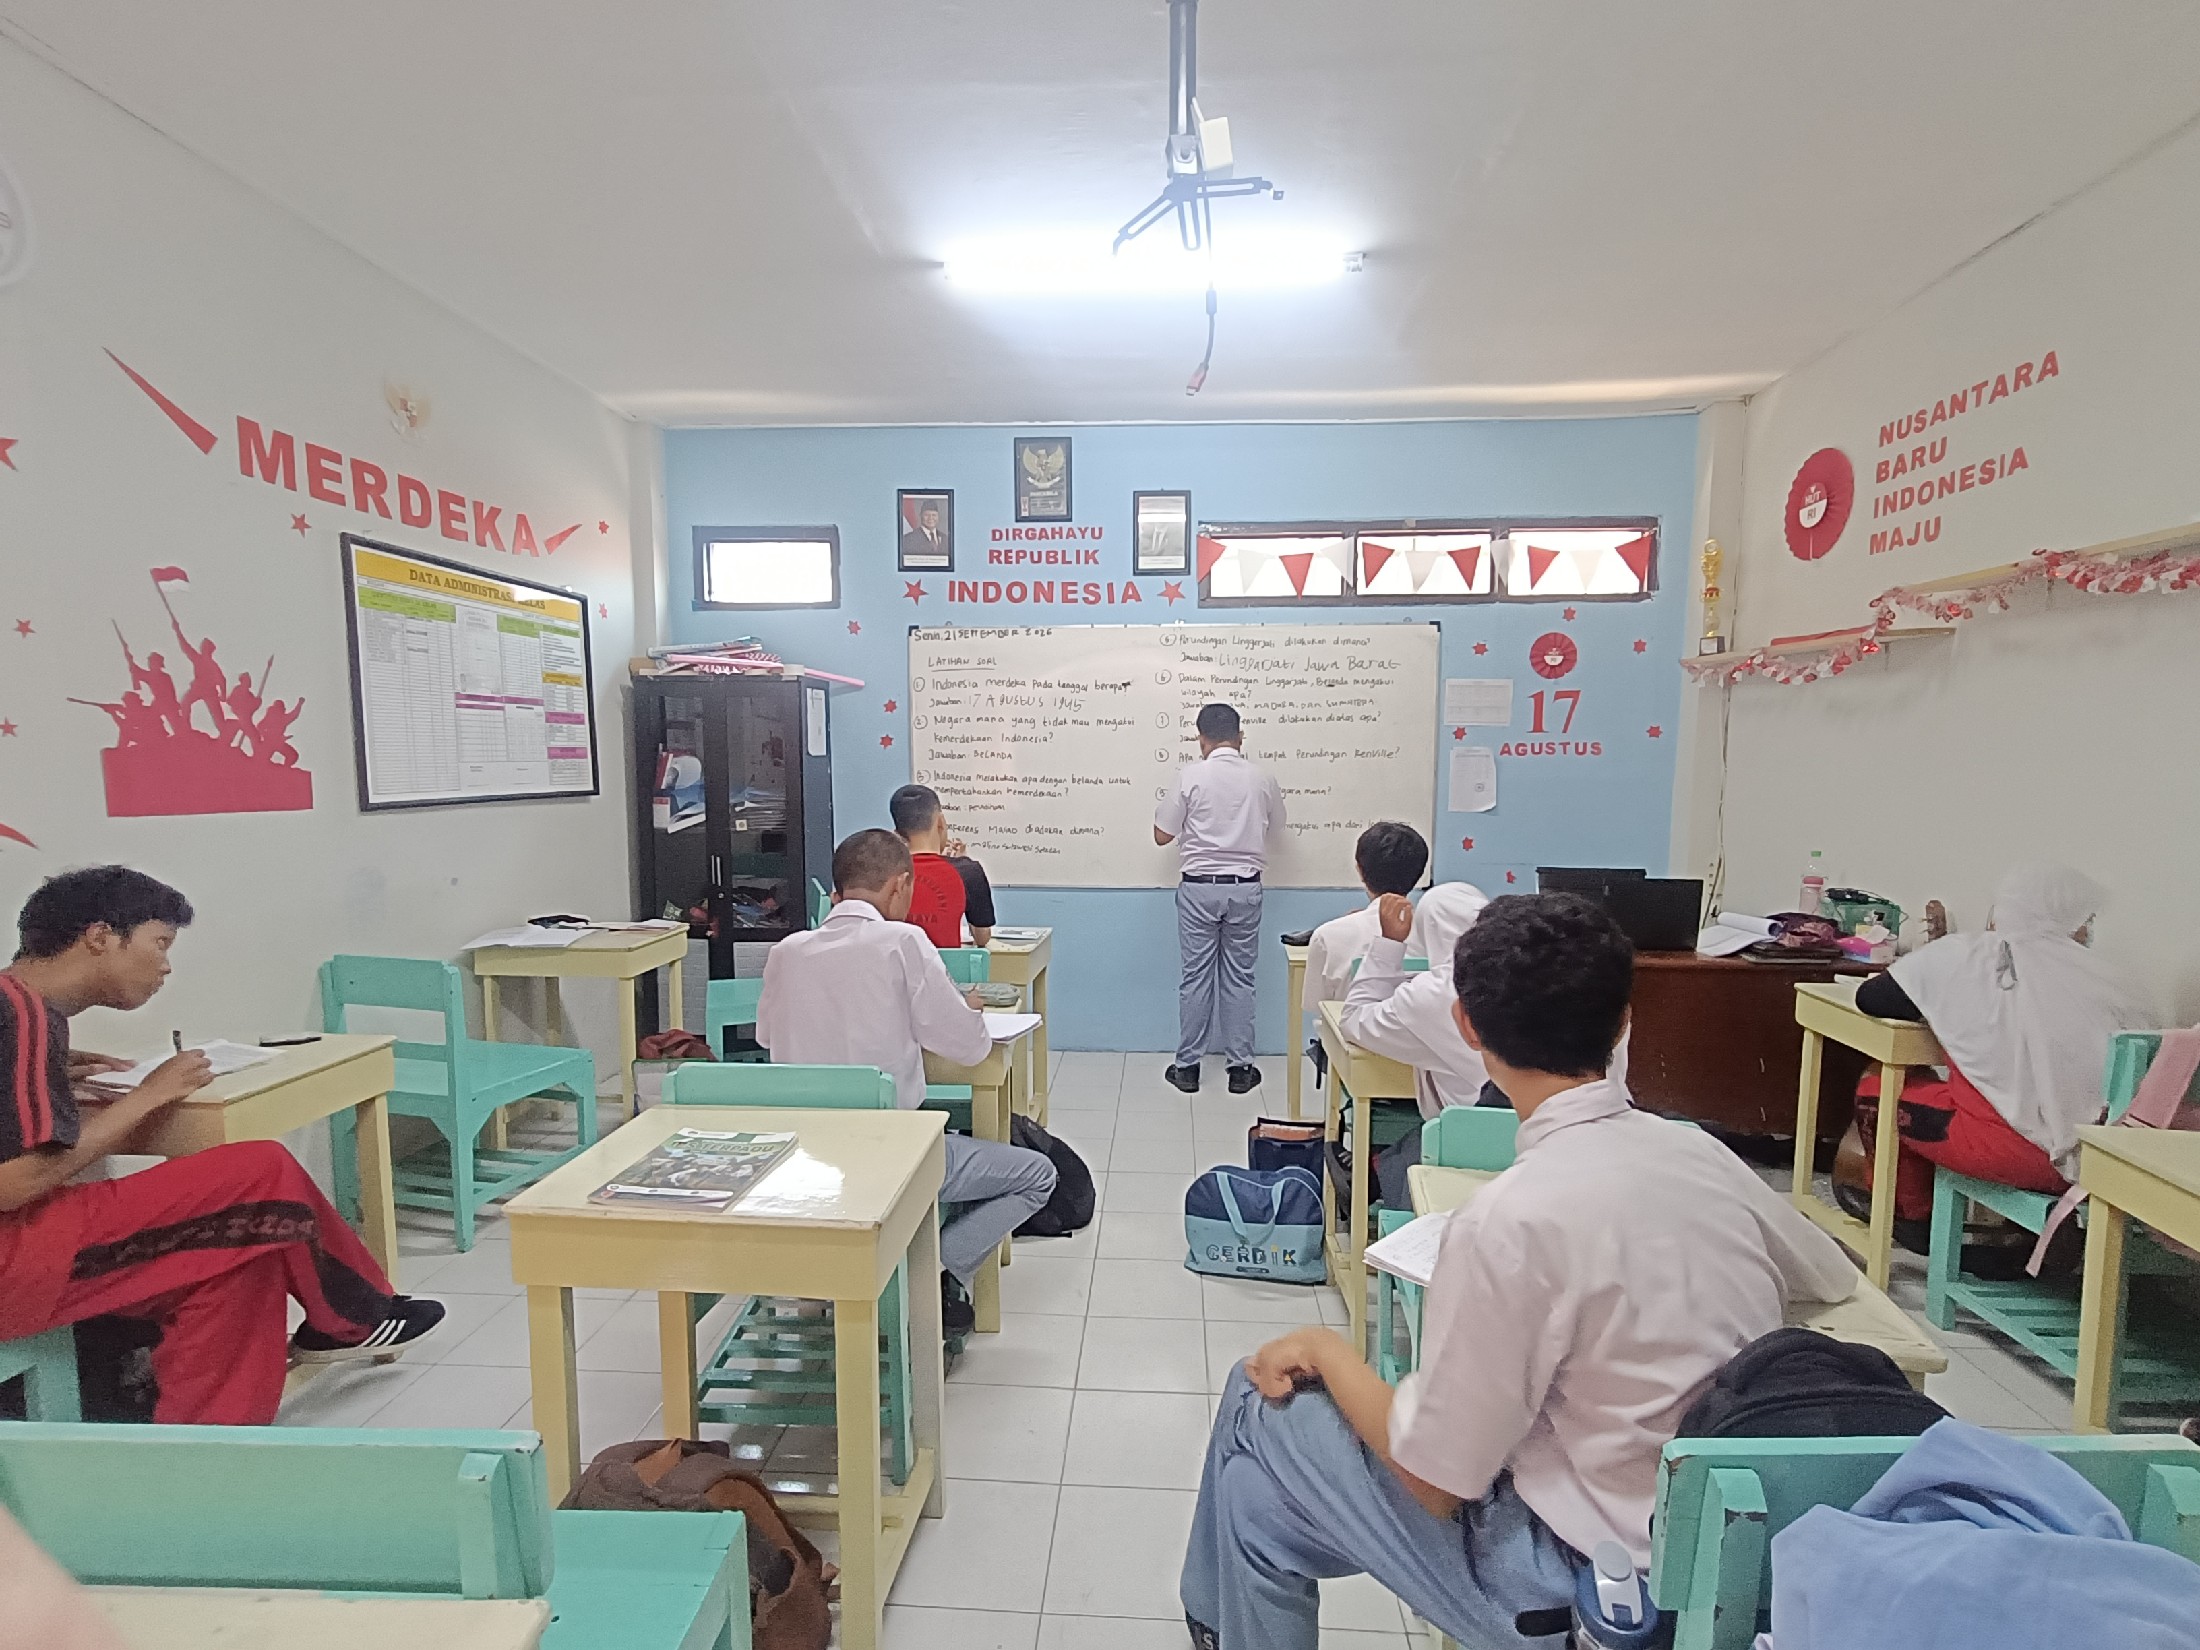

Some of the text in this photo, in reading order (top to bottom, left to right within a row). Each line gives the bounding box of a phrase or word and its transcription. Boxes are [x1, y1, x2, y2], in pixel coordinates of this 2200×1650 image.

[1879, 351, 2059, 447] NUSANTARA
[1876, 436, 1948, 484] BARU
[236, 415, 540, 557] MERDEKA
[1873, 447, 2028, 519] INDONESIA
[991, 526, 1103, 541] DIRGAHAYU
[1869, 516, 1941, 555] MAJU
[988, 549, 1100, 565] REPUBLIK
[409, 569, 441, 587] DATA
[948, 580, 1142, 605] INDONESIA
[932, 678, 978, 690] Indonesia
[1527, 689, 1581, 733] 17
[1500, 742, 1602, 756] AGUSTUS
